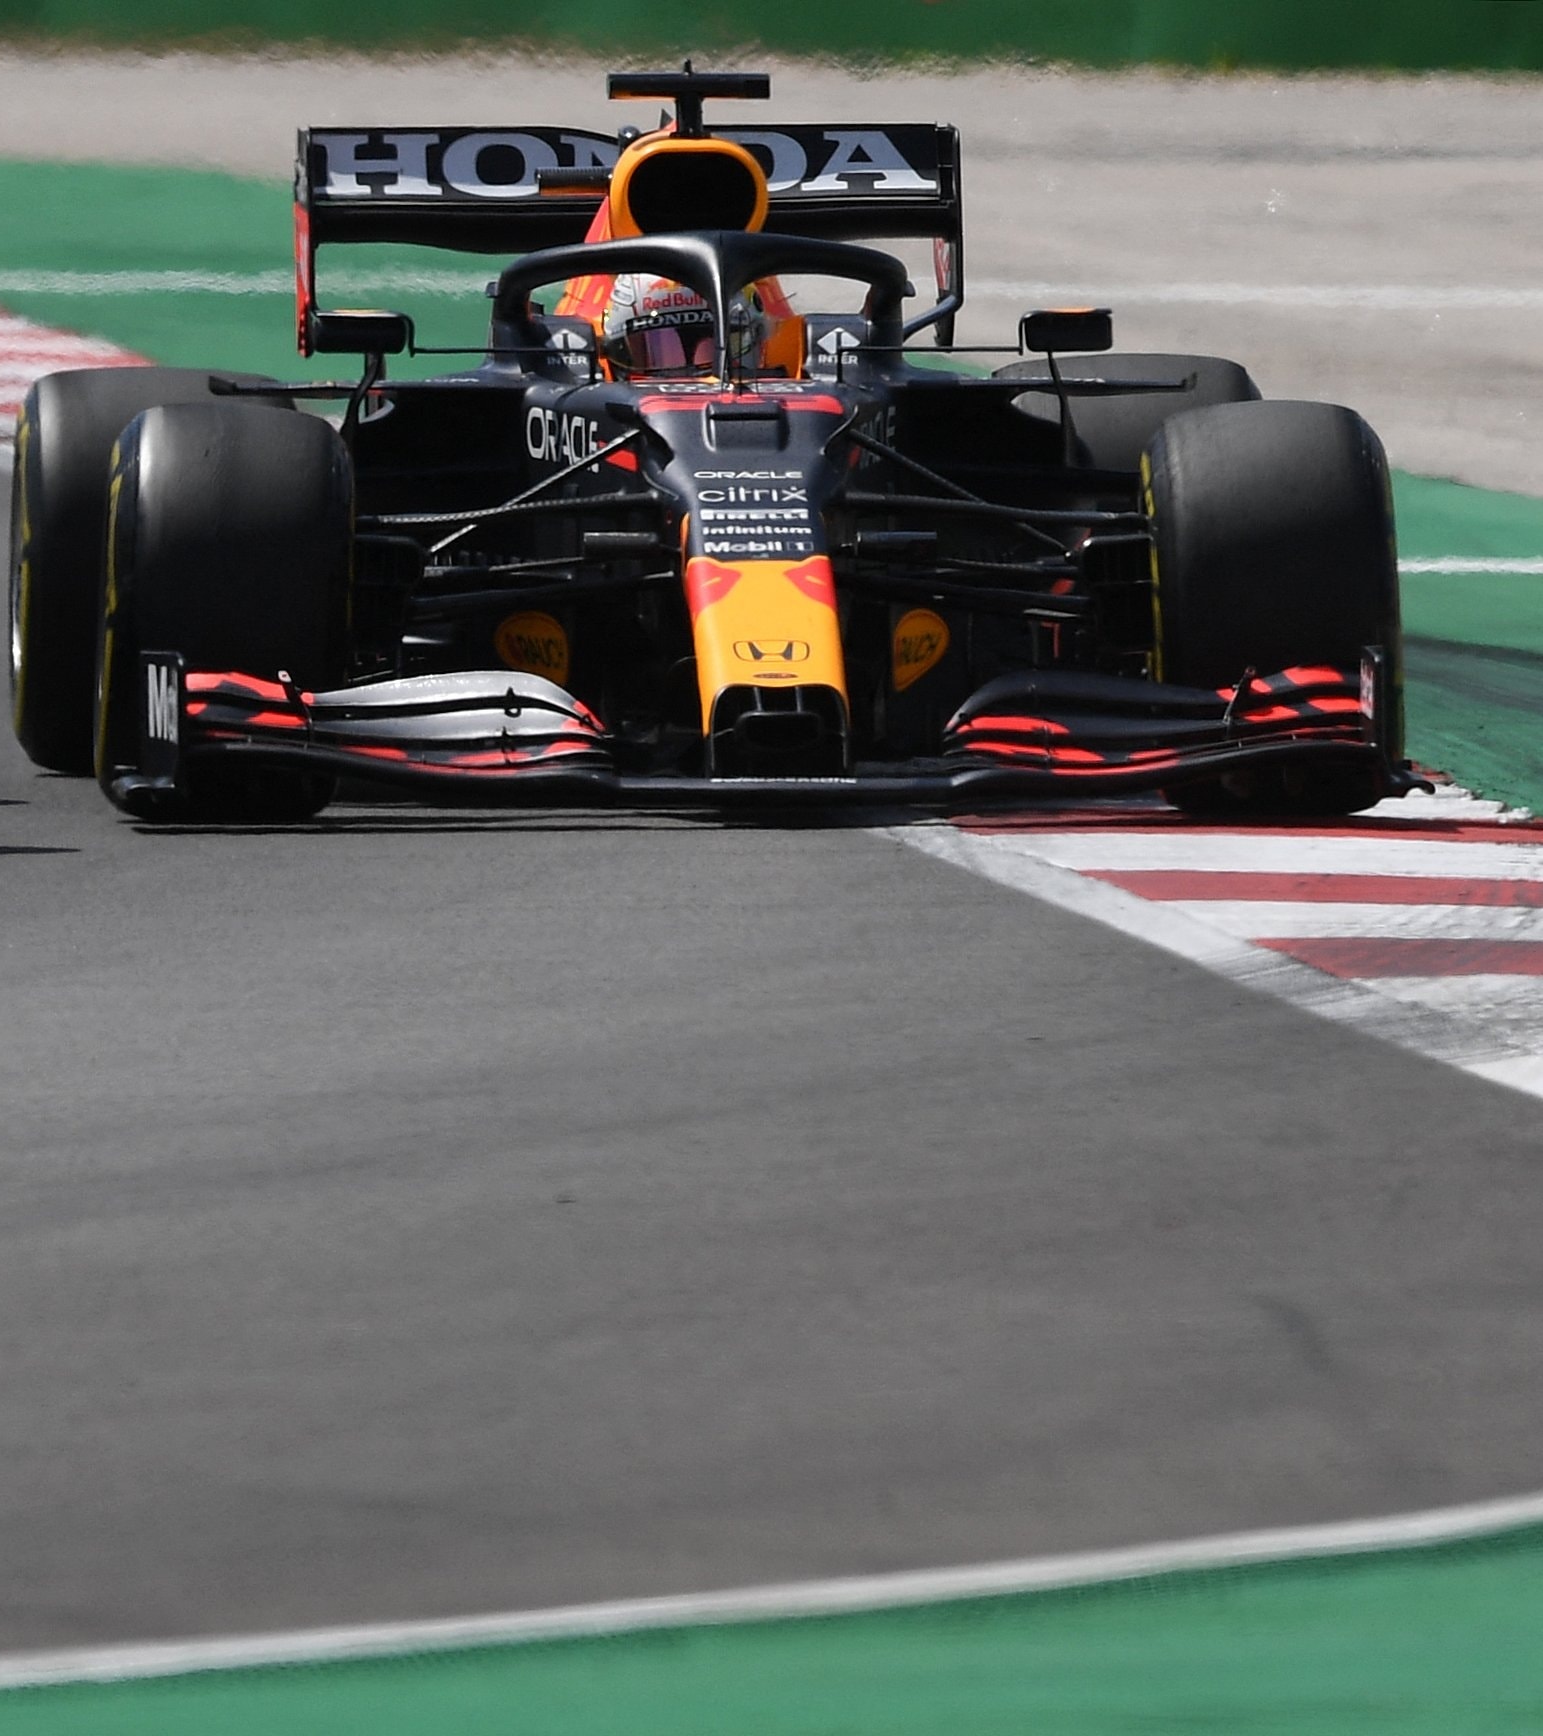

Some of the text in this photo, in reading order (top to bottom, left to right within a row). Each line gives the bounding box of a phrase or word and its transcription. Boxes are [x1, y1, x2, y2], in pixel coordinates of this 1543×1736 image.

[643, 296, 672, 310] Red
[631, 312, 714, 330] HONDA
[694, 471, 803, 479] ORACLE
[697, 486, 808, 502] citrix
[703, 541, 783, 553] Mobil
